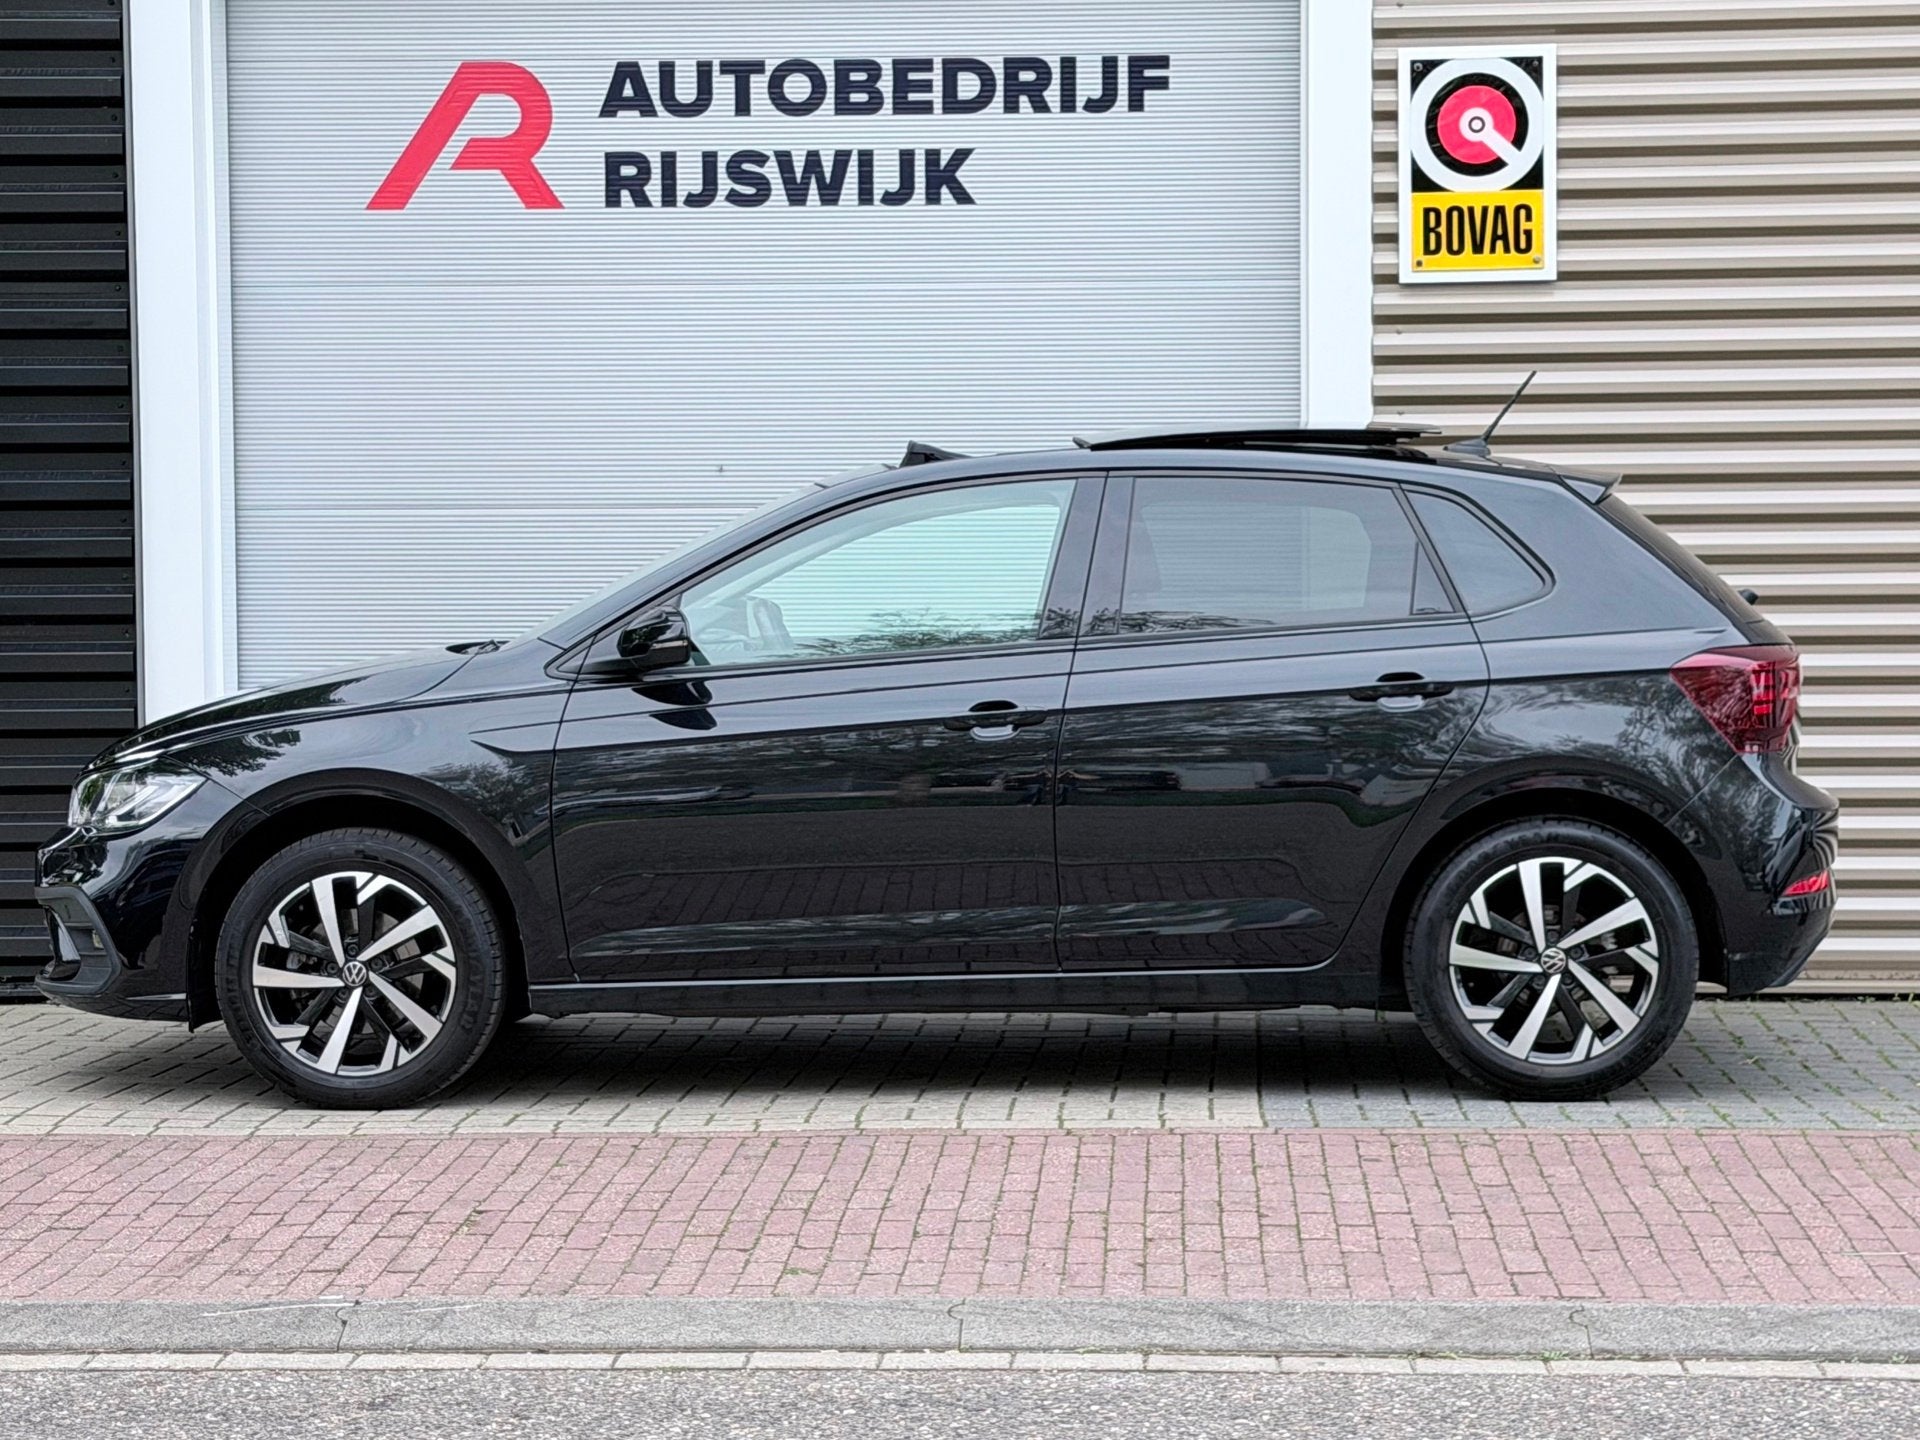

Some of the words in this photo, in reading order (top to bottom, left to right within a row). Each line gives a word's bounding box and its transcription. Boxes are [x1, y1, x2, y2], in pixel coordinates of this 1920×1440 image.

[599, 56, 1169, 117] AUTOBEDRIJF
[605, 149, 975, 207] RIJSWIJK
[1423, 204, 1532, 255] BOVAG
